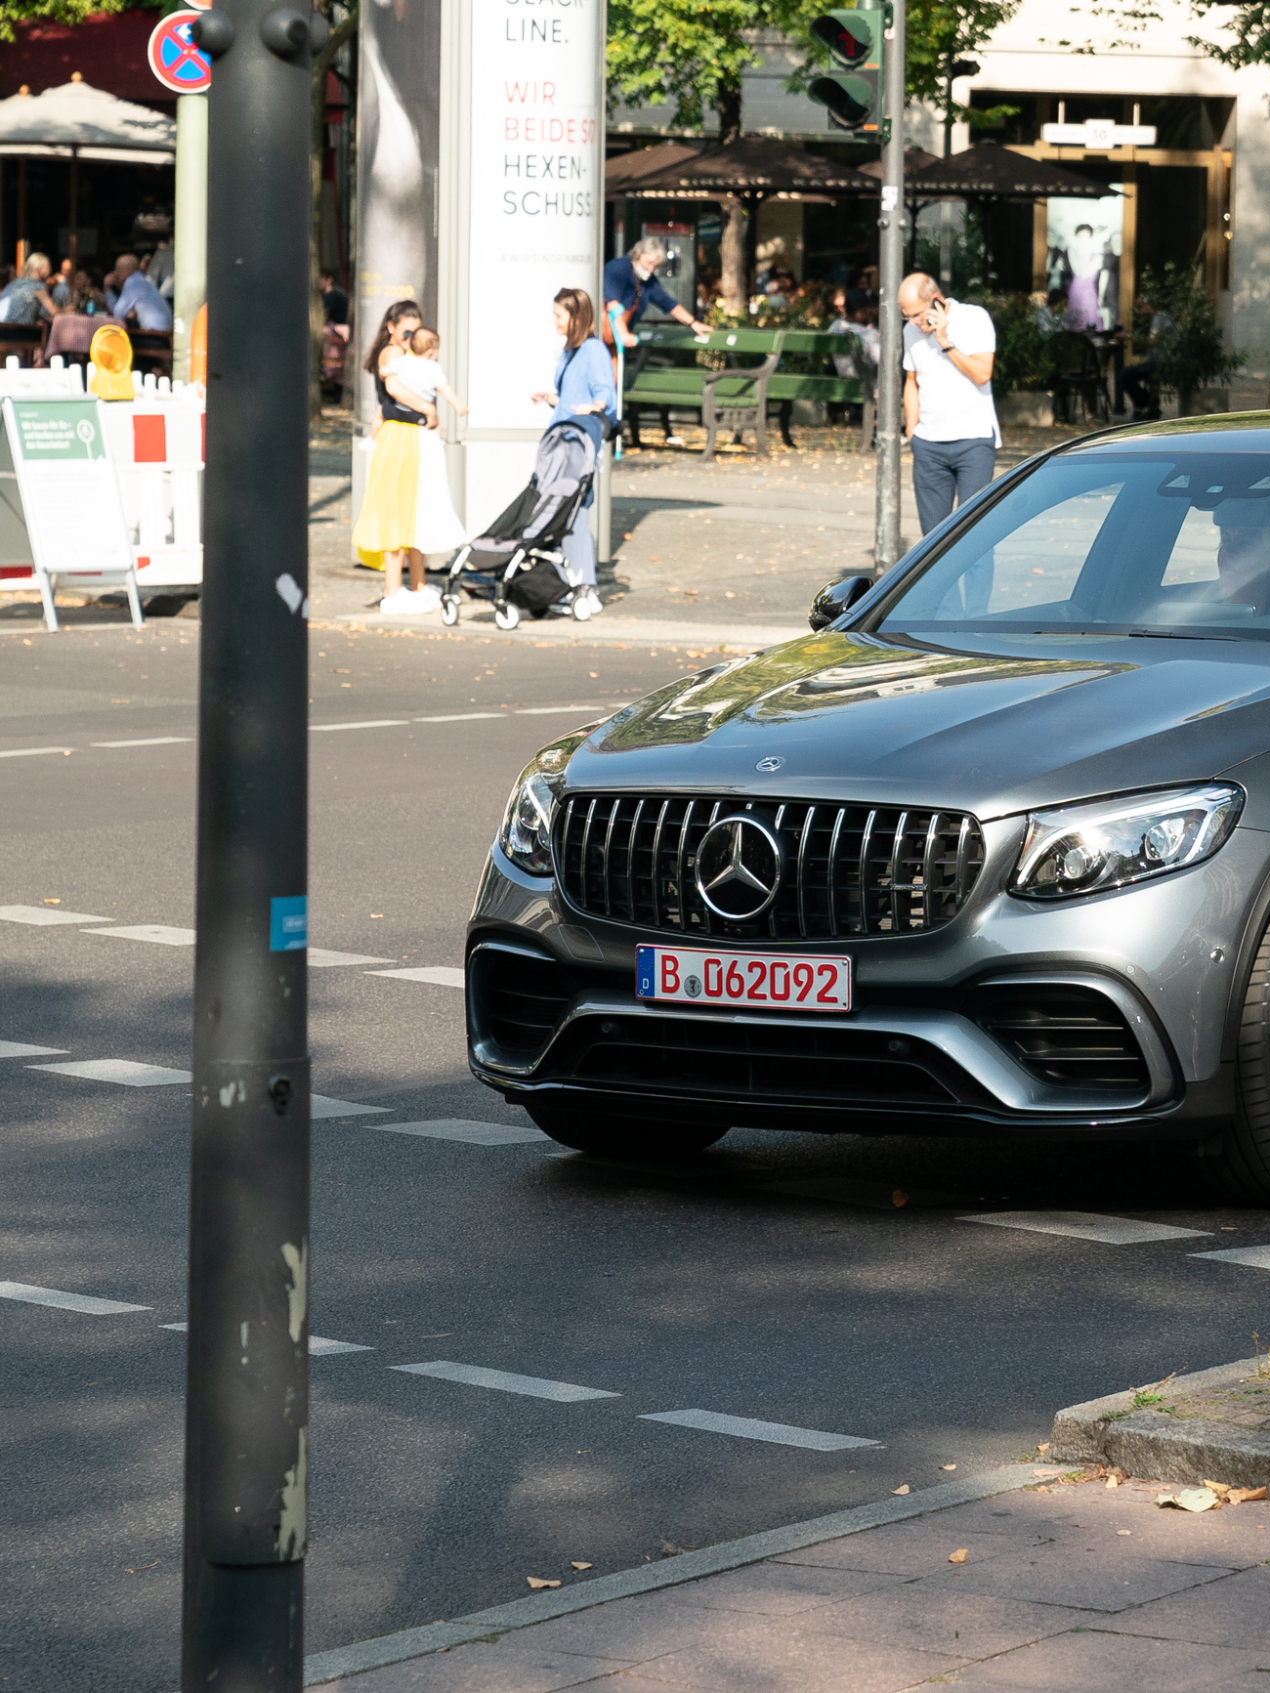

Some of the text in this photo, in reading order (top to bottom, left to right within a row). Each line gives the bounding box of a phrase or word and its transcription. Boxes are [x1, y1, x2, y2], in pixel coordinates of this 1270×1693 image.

[506, 18, 568, 43] LINE.
[504, 81, 556, 105] WIR
[504, 154, 587, 179] HEXEN-
[503, 190, 593, 217] SCHUSS
[642, 978, 650, 989] D
[660, 953, 839, 1004] B 062092
